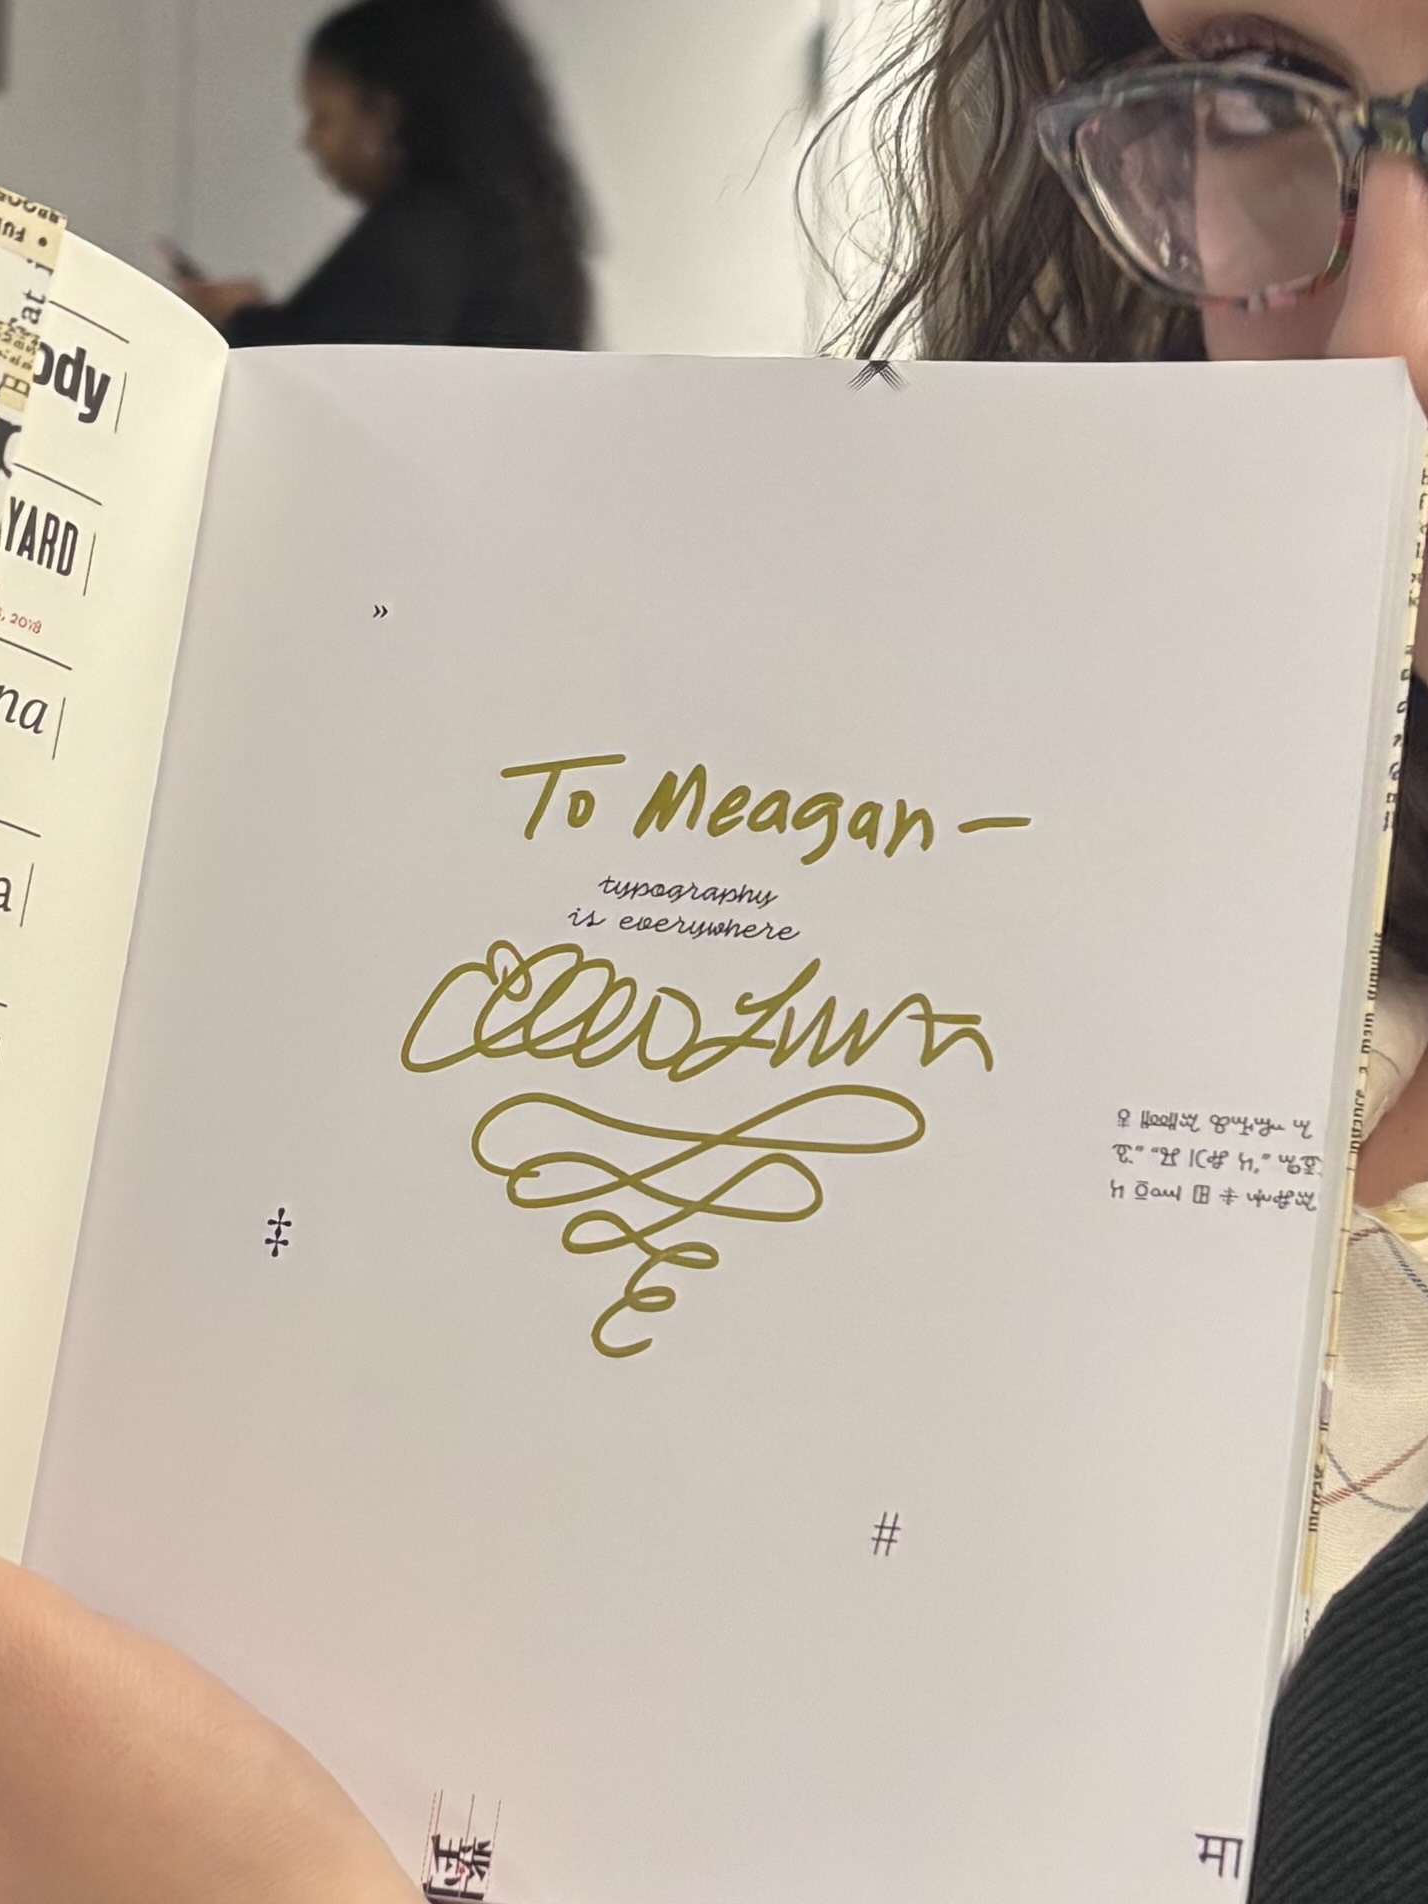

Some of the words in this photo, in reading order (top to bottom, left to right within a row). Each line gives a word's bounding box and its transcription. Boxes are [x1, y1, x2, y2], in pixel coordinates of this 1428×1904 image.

[501, 754, 627, 840] To
[632, 763, 934, 866] Meagan
[598, 875, 779, 910] typography
[567, 907, 607, 929] is
[619, 913, 802, 941] everywhere
